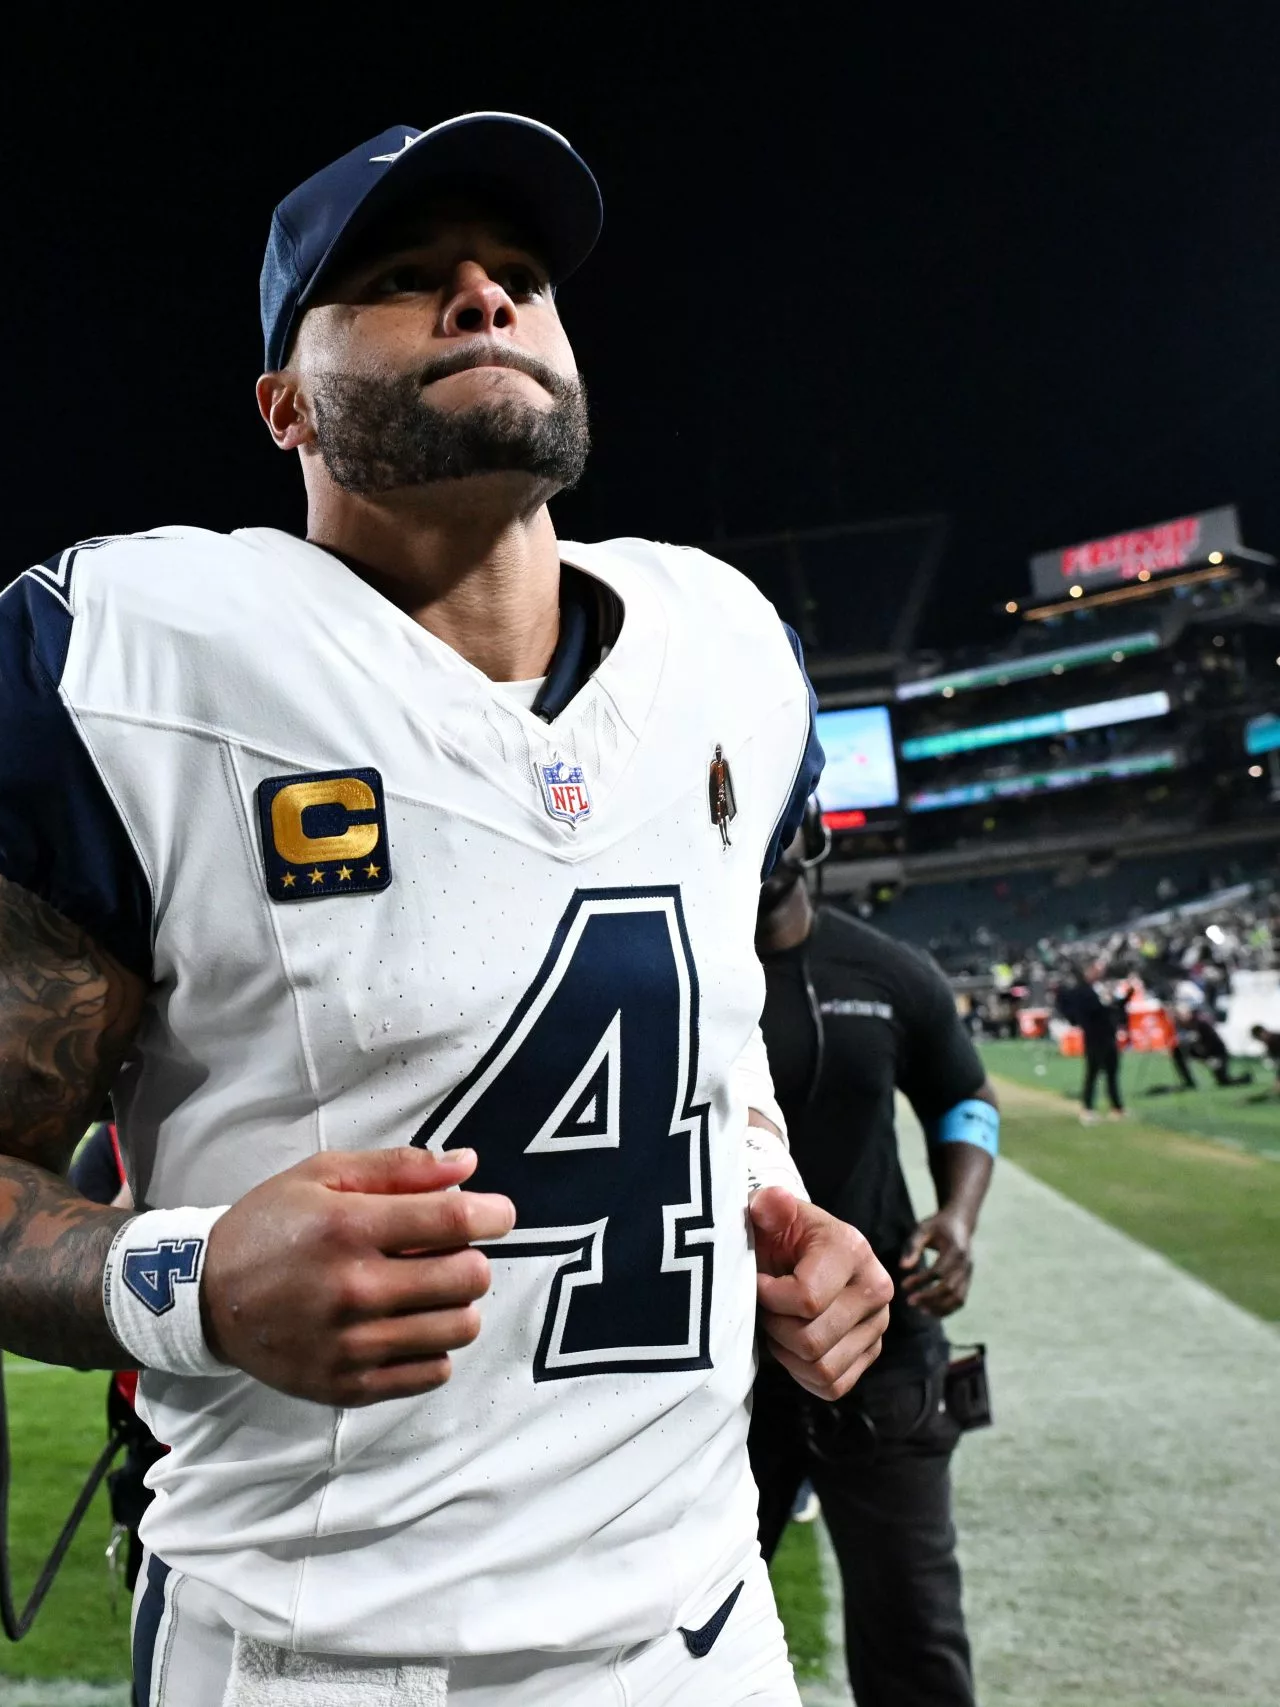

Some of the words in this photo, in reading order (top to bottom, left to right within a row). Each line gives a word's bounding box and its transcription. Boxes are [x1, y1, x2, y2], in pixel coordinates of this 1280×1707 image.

[271, 777, 379, 864] C
[551, 786, 588, 814] NFL
[410, 884, 715, 1382] 4
[104, 1262, 113, 1306] FIGHT
[122, 1239, 204, 1316] 4
